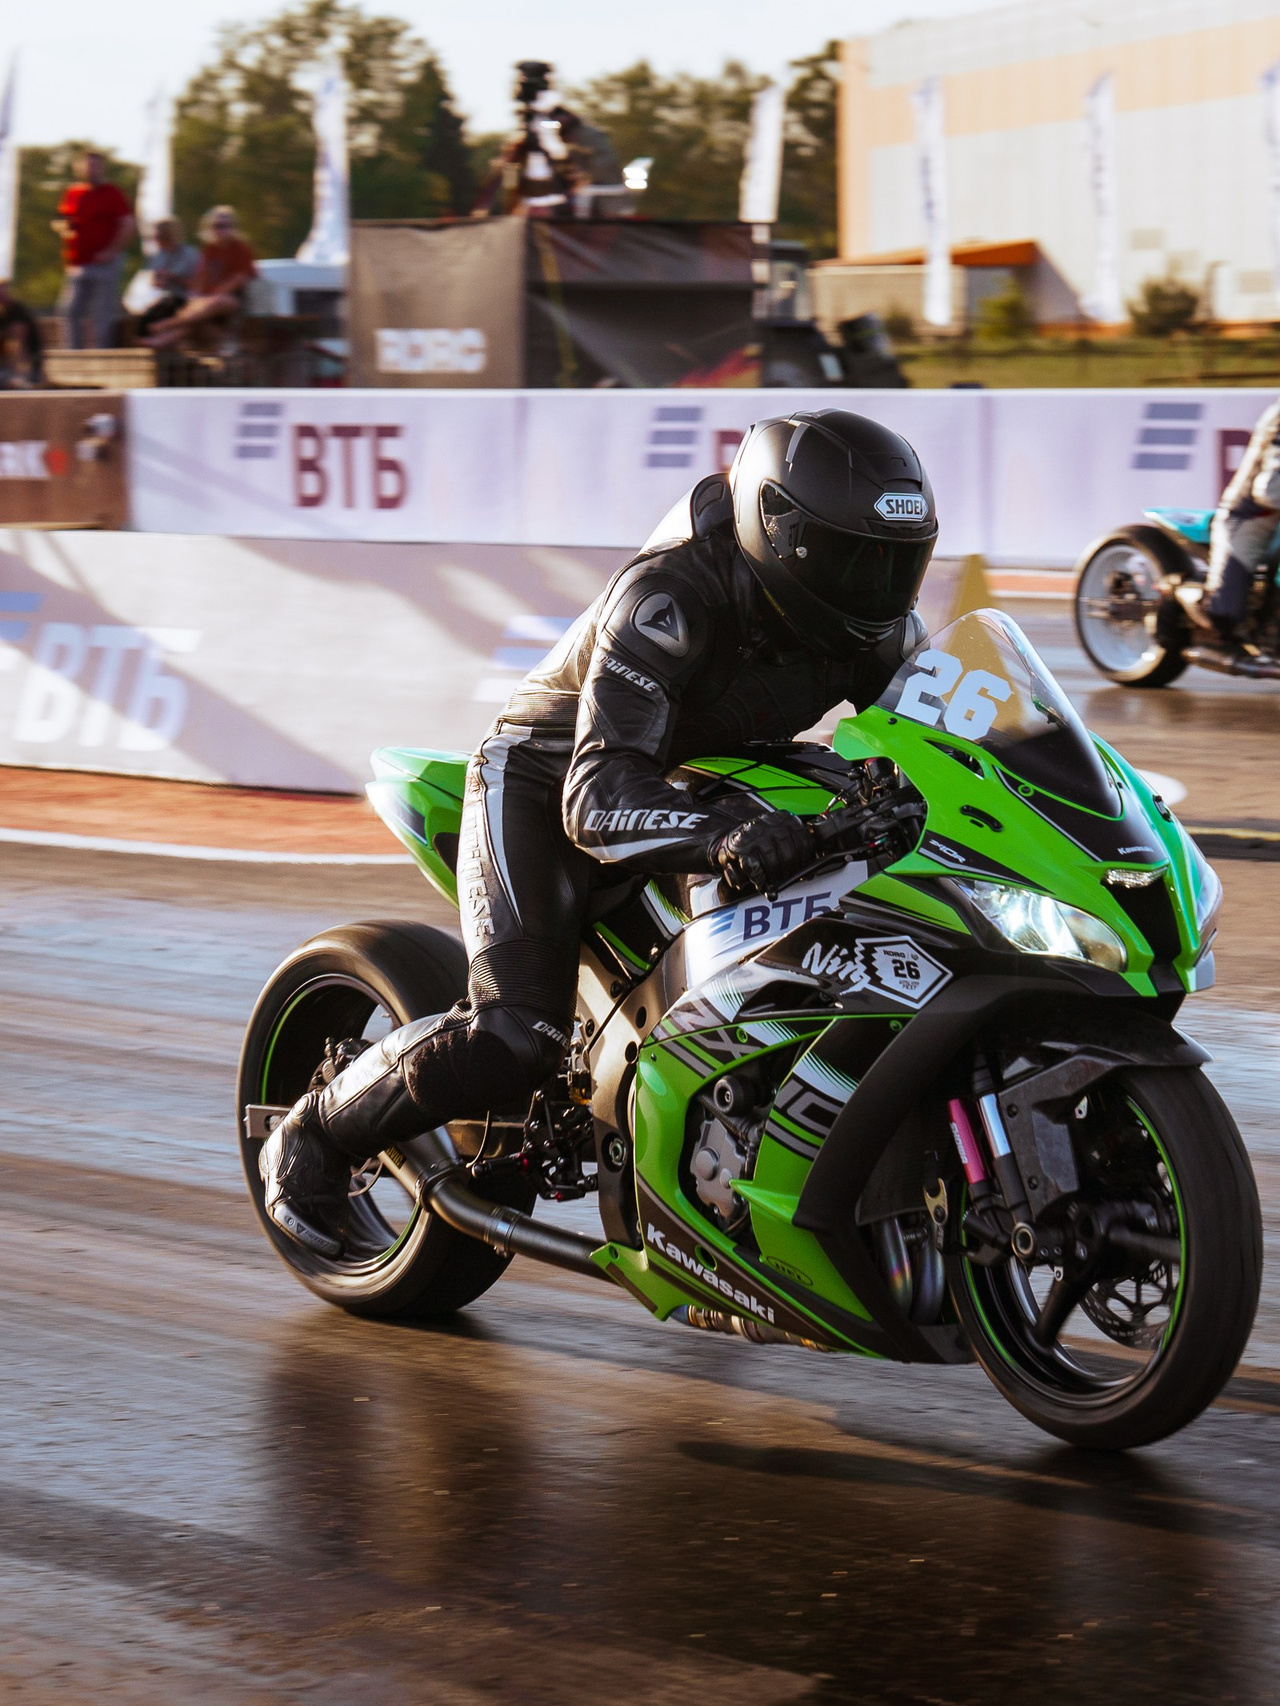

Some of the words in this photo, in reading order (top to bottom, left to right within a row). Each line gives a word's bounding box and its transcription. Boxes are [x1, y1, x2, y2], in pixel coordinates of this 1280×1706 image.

[292, 423, 409, 509] ВТБ
[885, 498, 923, 516] SHOEI
[12, 621, 203, 752] ВТБ
[895, 649, 1012, 741] 26
[891, 959, 921, 980] 26
[647, 1222, 776, 1325] Kawasaki
